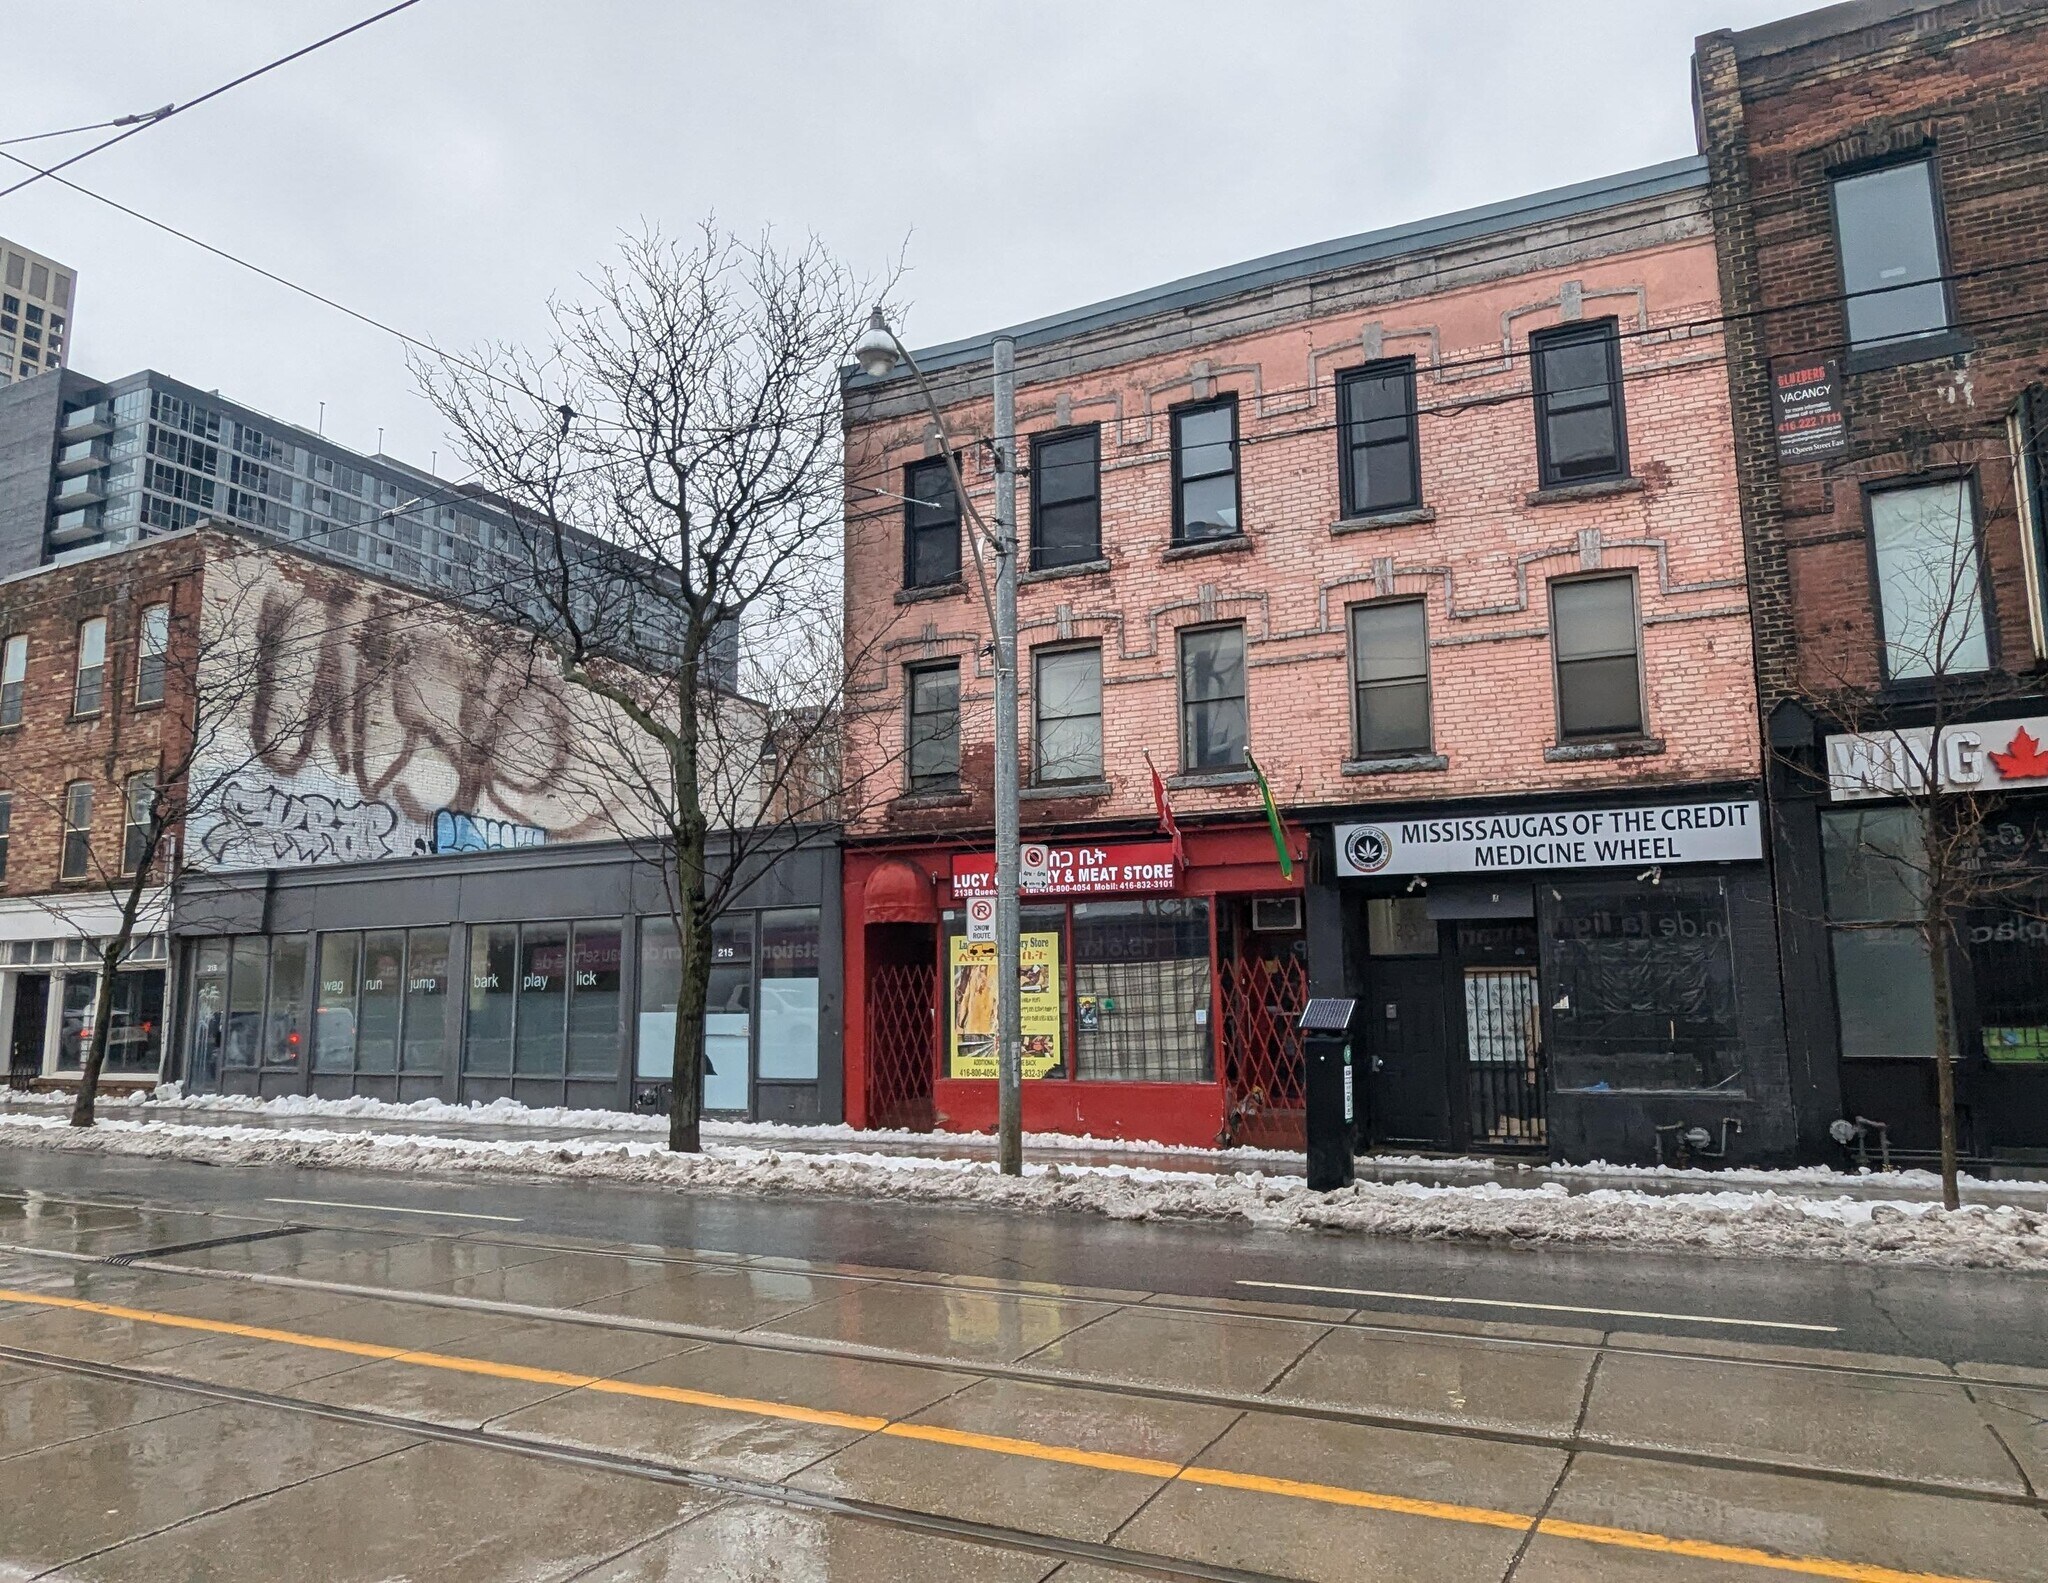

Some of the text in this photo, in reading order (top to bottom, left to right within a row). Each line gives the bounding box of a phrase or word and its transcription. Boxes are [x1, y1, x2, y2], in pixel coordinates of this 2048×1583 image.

[1780, 384, 1832, 403] VACANCY
[1792, 446, 1813, 455] Queen
[1813, 441, 1831, 450] Street
[1832, 731, 1984, 792] WING
[1401, 804, 1750, 844] MISSISSAUGAS OF THE CREDIT
[1079, 848, 1107, 866] ቤት
[1474, 837, 1682, 867] MEDICINE WHEEL
[953, 873, 990, 888] LUCY
[1064, 869, 1075, 883] &
[1078, 867, 1118, 882] MEAT
[1123, 864, 1173, 880] STORE
[954, 889, 974, 897] 213B
[1094, 882, 1118, 891] Mobil:
[1119, 880, 1173, 890] 416-832-3101
[1030, 937, 1049, 947] Store
[718, 948, 733, 957] 215
[365, 979, 383, 990] run
[409, 978, 436, 993] jump
[473, 973, 499, 988] bark
[523, 972, 549, 991] play
[576, 970, 597, 986] lick
[323, 980, 344, 994] wag
